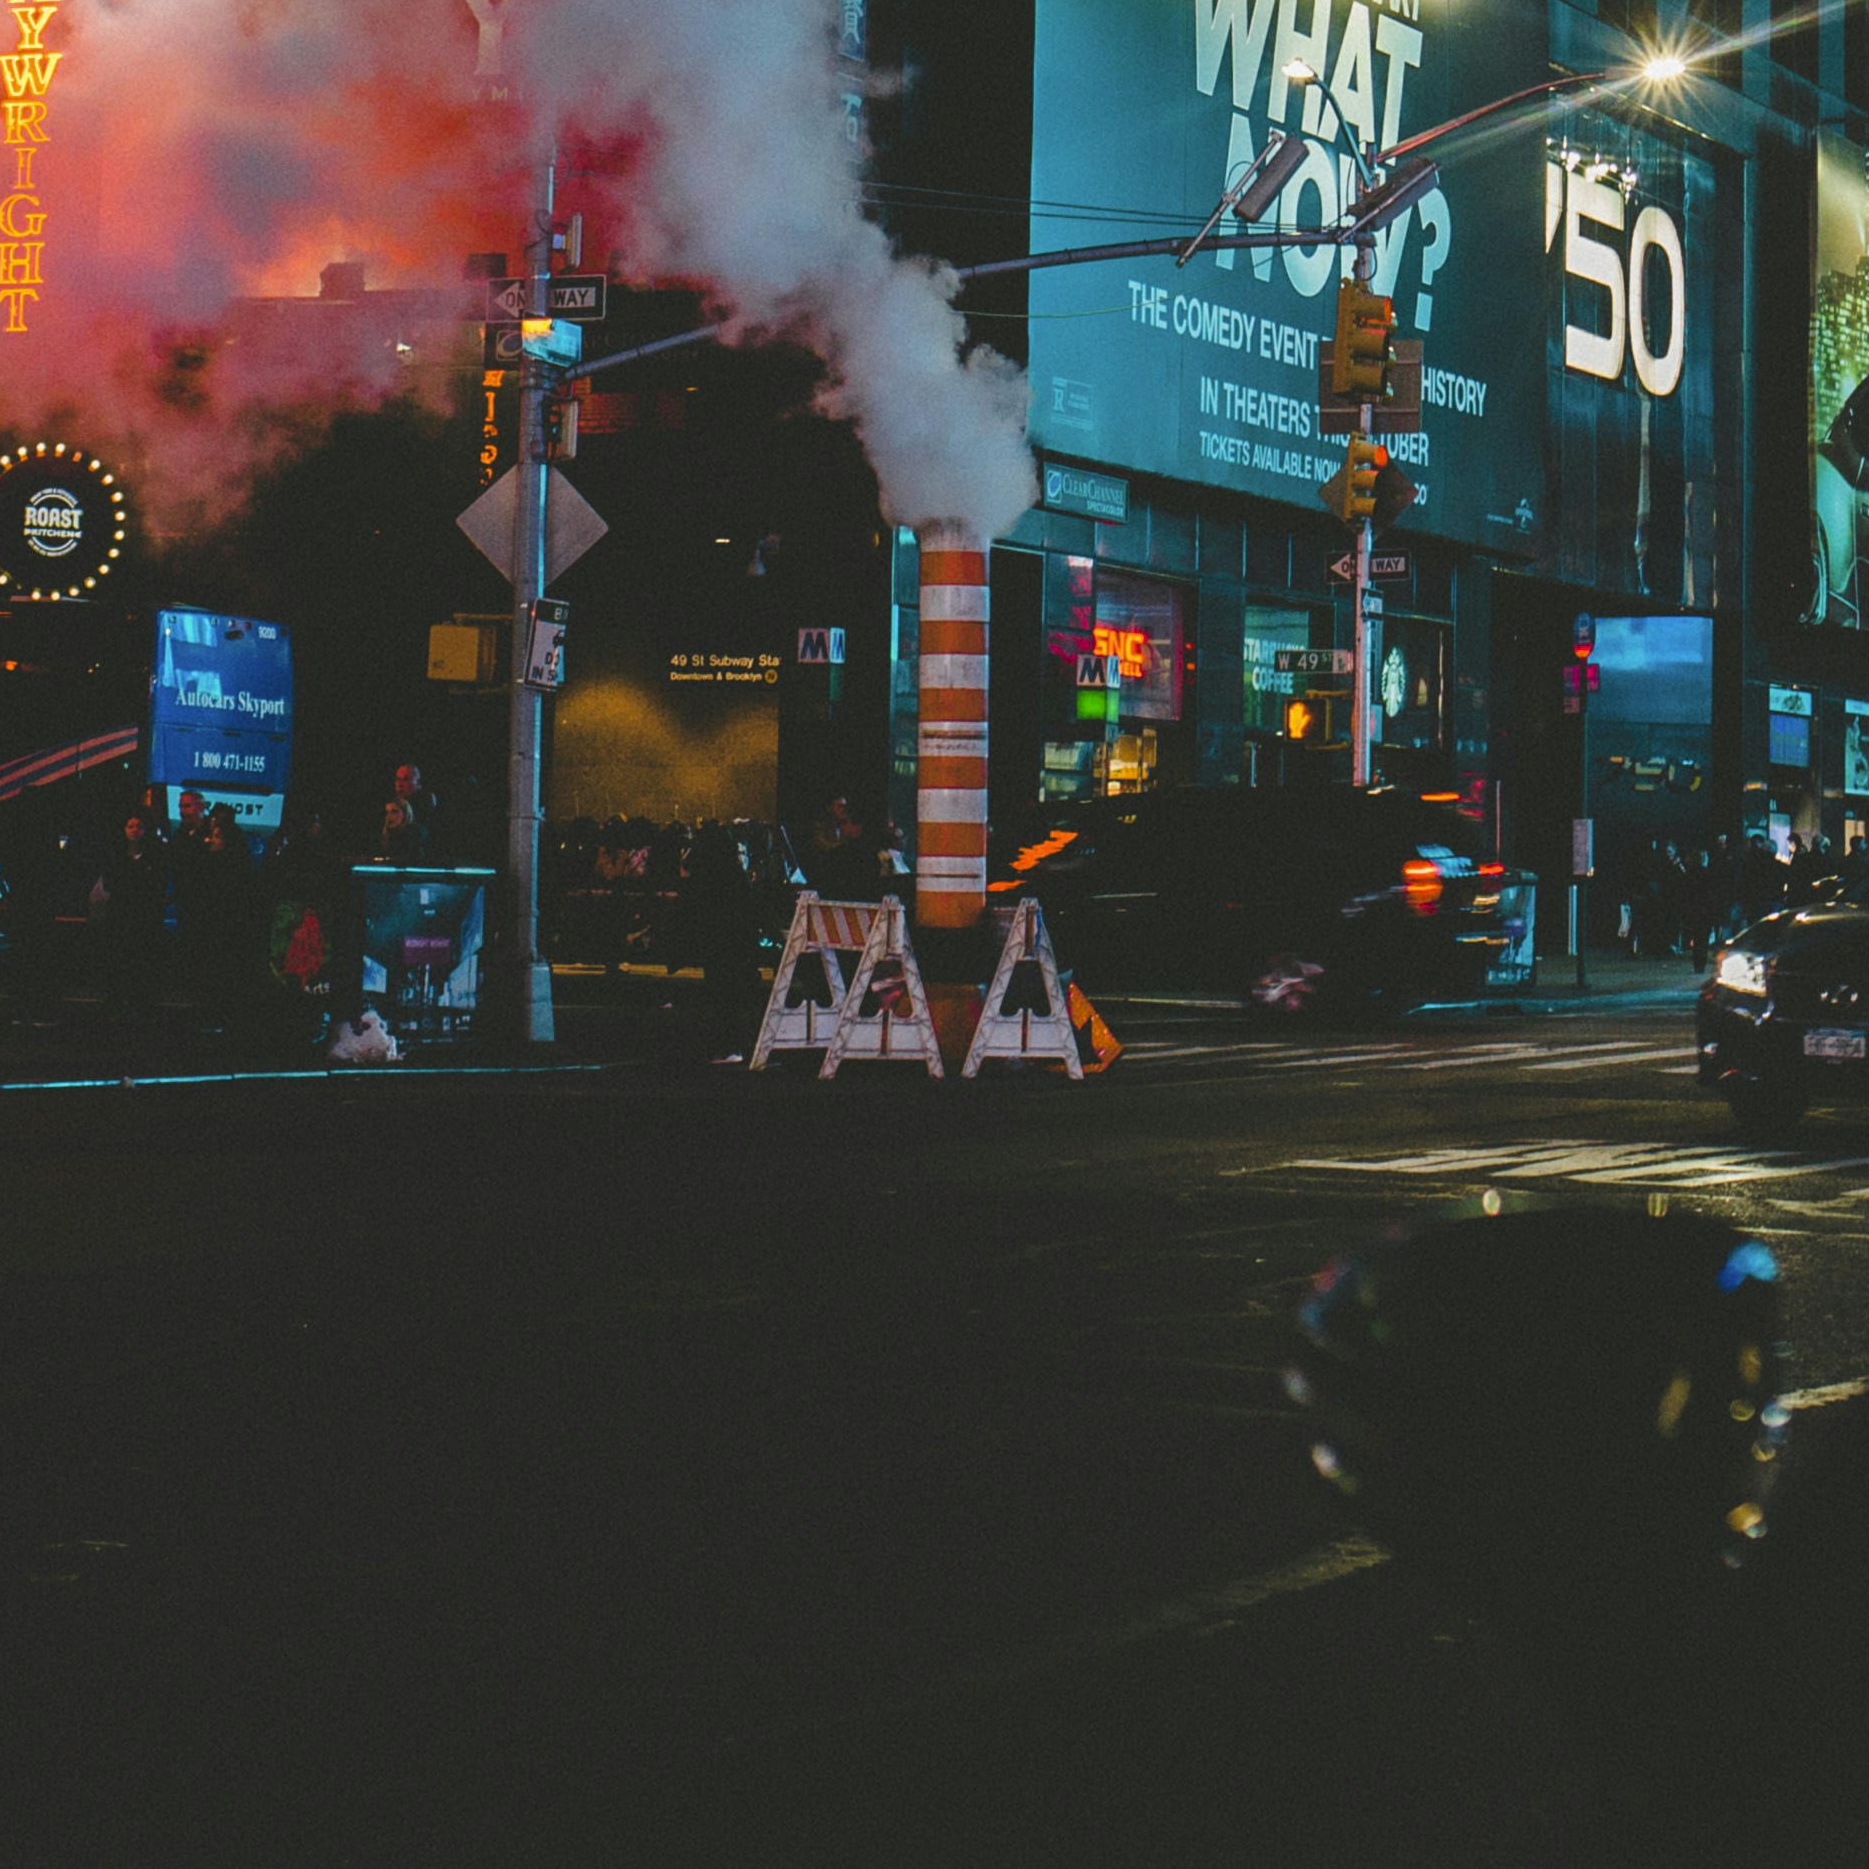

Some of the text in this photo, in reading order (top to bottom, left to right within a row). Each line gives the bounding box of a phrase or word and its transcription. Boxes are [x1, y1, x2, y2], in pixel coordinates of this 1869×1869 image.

[505, 289, 589, 308] ON WAY
[1128, 279, 1168, 328] THE
[1172, 294, 1255, 356] COMEDY
[1259, 317, 1318, 370] EVENT
[1199, 376, 1217, 415] IN
[1222, 382, 1311, 432] THEATERS
[1199, 430, 1251, 468] TICKETS
[1252, 443, 1311, 481] AVAILABLE
[24, 507, 84, 530] ROAST
[1375, 558, 1402, 572] WAY
[1093, 627, 1147, 662] GNC
[670, 654, 688, 667] 49
[709, 653, 754, 670] Subway
[758, 653, 781, 667] Sta
[1278, 653, 1291, 671] W
[1297, 652, 1319, 671] 49
[1251, 665, 1294, 695] COFFEE
[175, 689, 285, 719] Autocars Skyport
[193, 751, 266, 773] 1 800 471-1155
